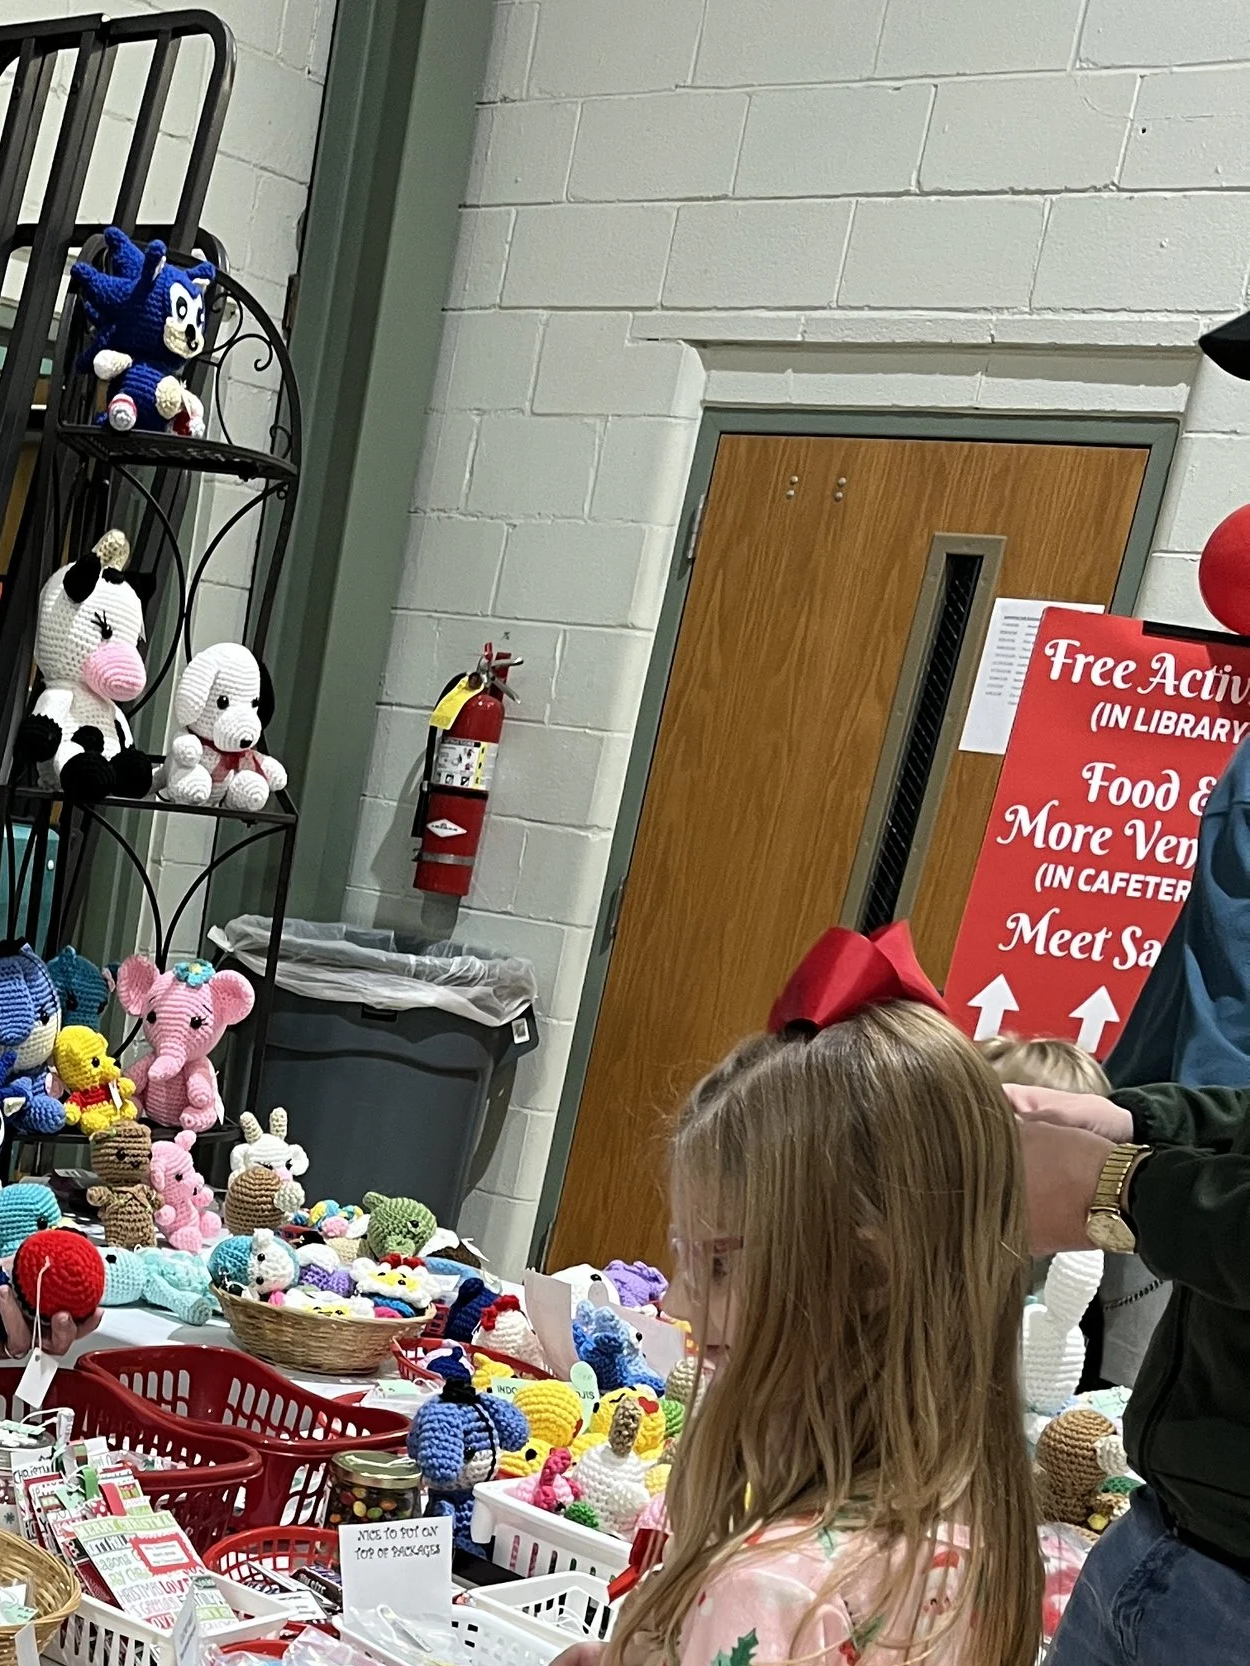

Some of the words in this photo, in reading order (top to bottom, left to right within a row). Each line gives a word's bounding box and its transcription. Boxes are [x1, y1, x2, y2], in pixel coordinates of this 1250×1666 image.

[1044, 638, 1137, 690] Free
[1136, 652, 1250, 706] Activ
[1090, 701, 1132, 733] (IN
[1081, 761, 1181, 812] Food
[1188, 776, 1218, 817] &
[996, 799, 1113, 856] More
[1034, 862, 1074, 893] (IN
[997, 907, 1113, 962] Meet
[355, 1547, 375, 1560] TOP
[377, 1547, 389, 1559] OF
[391, 1544, 440, 1558] PACKAGES
[358, 1529, 382, 1541] NICE
[384, 1527, 398, 1539] TO
[400, 1525, 419, 1539] PUT
[422, 1526, 438, 1538] ON
